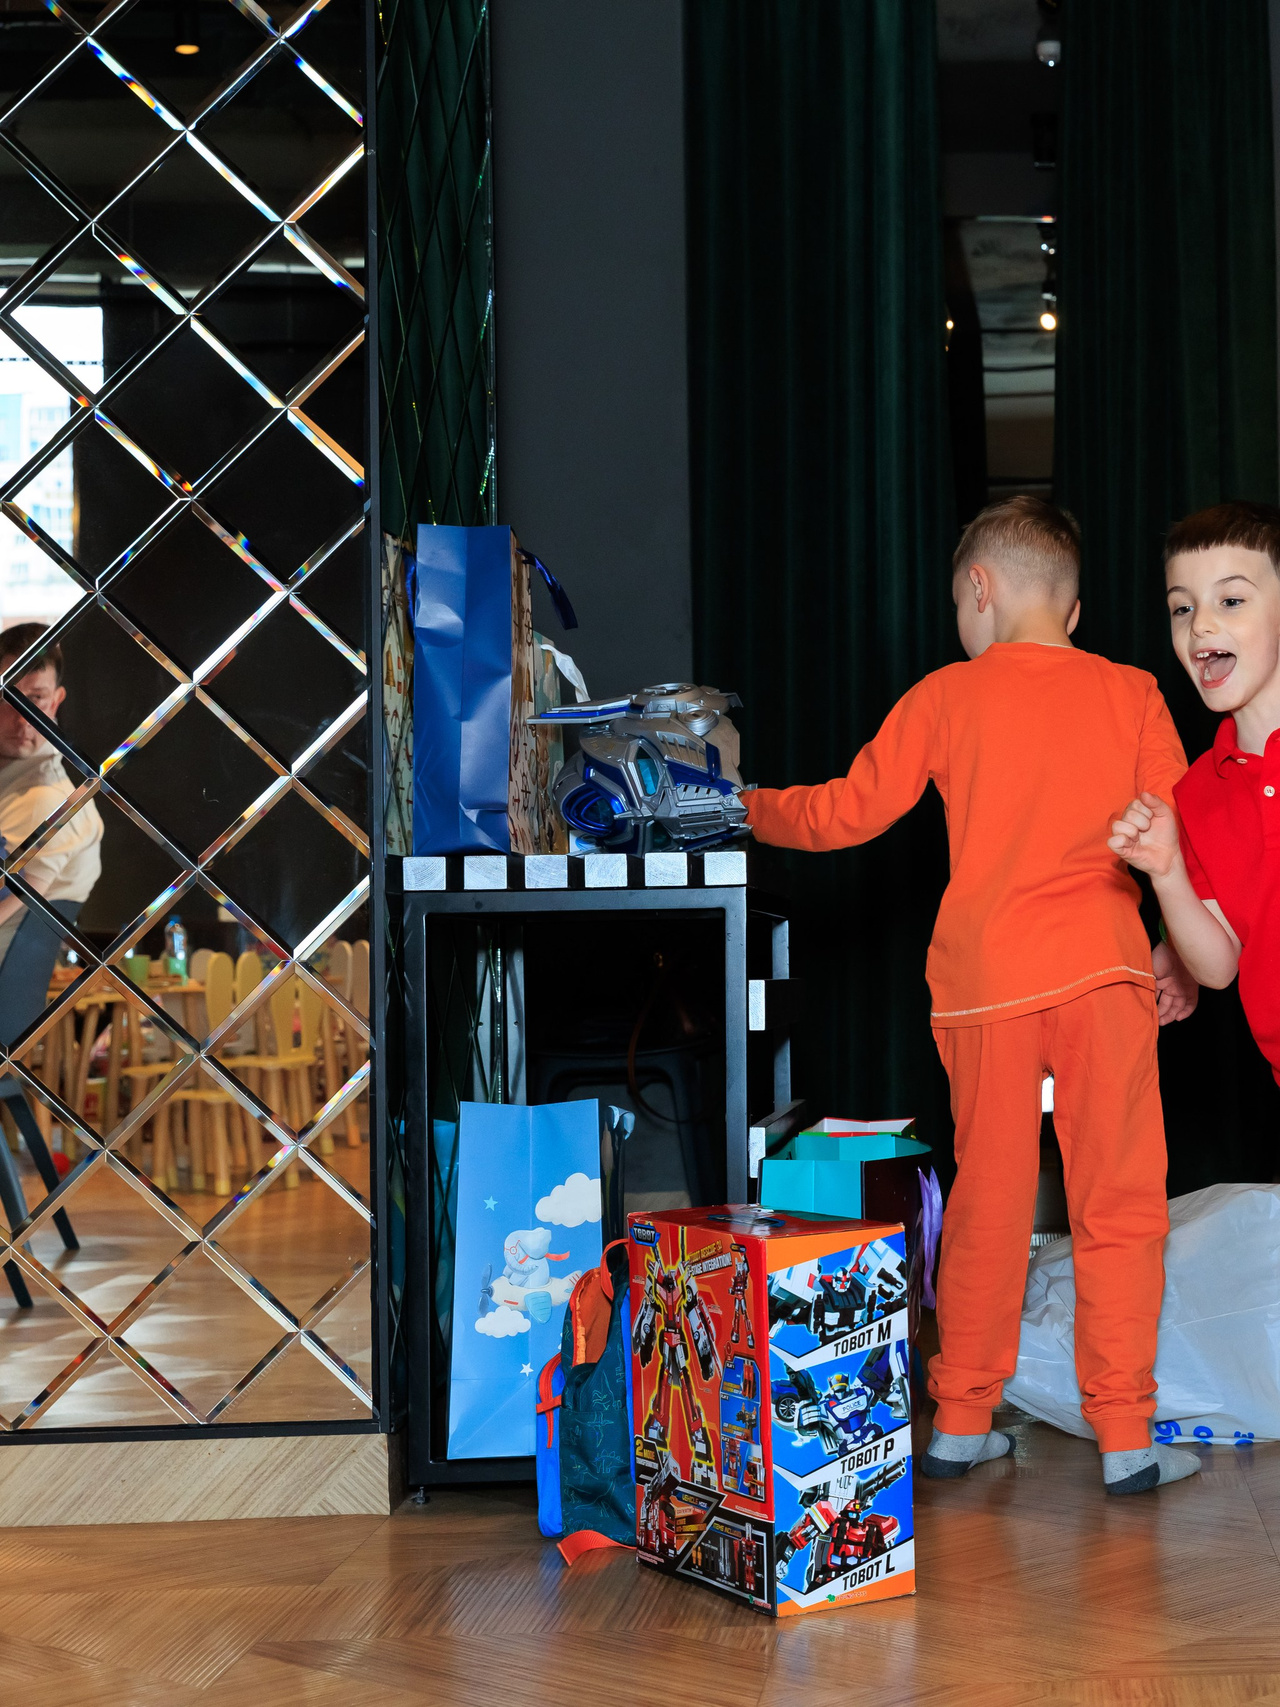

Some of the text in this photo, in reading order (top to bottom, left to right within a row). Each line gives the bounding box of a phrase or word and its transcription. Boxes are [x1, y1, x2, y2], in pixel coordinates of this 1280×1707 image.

[633, 1227, 655, 1242] TOBOT
[834, 1319, 892, 1357] TOBOT M
[842, 1400, 861, 1412] POLICE
[635, 1440, 643, 1456] 2
[841, 1437, 895, 1474] TOBOT P
[843, 1553, 895, 1591] TOBOT L
